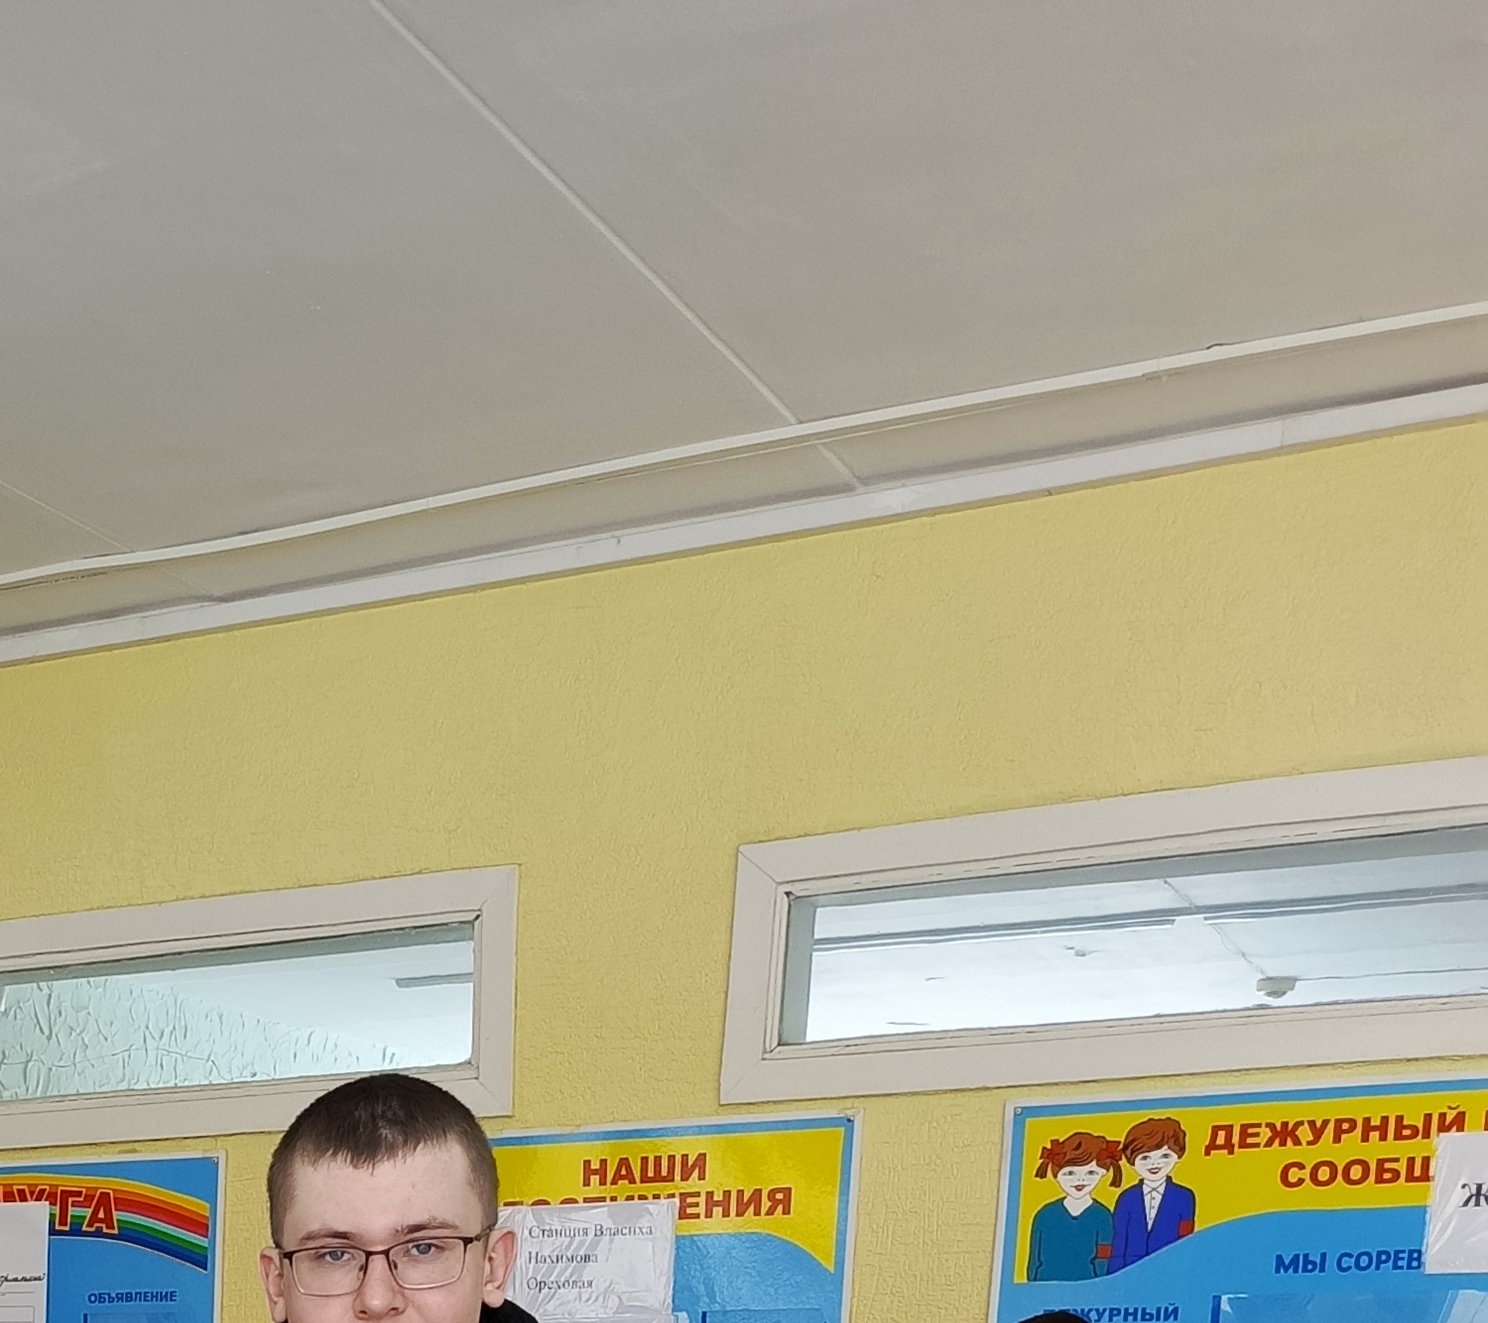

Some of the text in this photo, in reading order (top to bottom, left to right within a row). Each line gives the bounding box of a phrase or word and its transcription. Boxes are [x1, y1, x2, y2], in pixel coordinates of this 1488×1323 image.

[1204, 1104, 1467, 1157] ДЕЖУРНЫЙ
[582, 1152, 708, 1187] НАШИ
[528, 1223, 654, 1240] Станция Власиха
[527, 1251, 599, 1265] Нахимова
[1274, 1249, 1423, 1275] МЫ СОРЕВ
[526, 1276, 594, 1294] Ореховая
[88, 1291, 177, 1304] ОБЪЯВЛЕНИЕ
